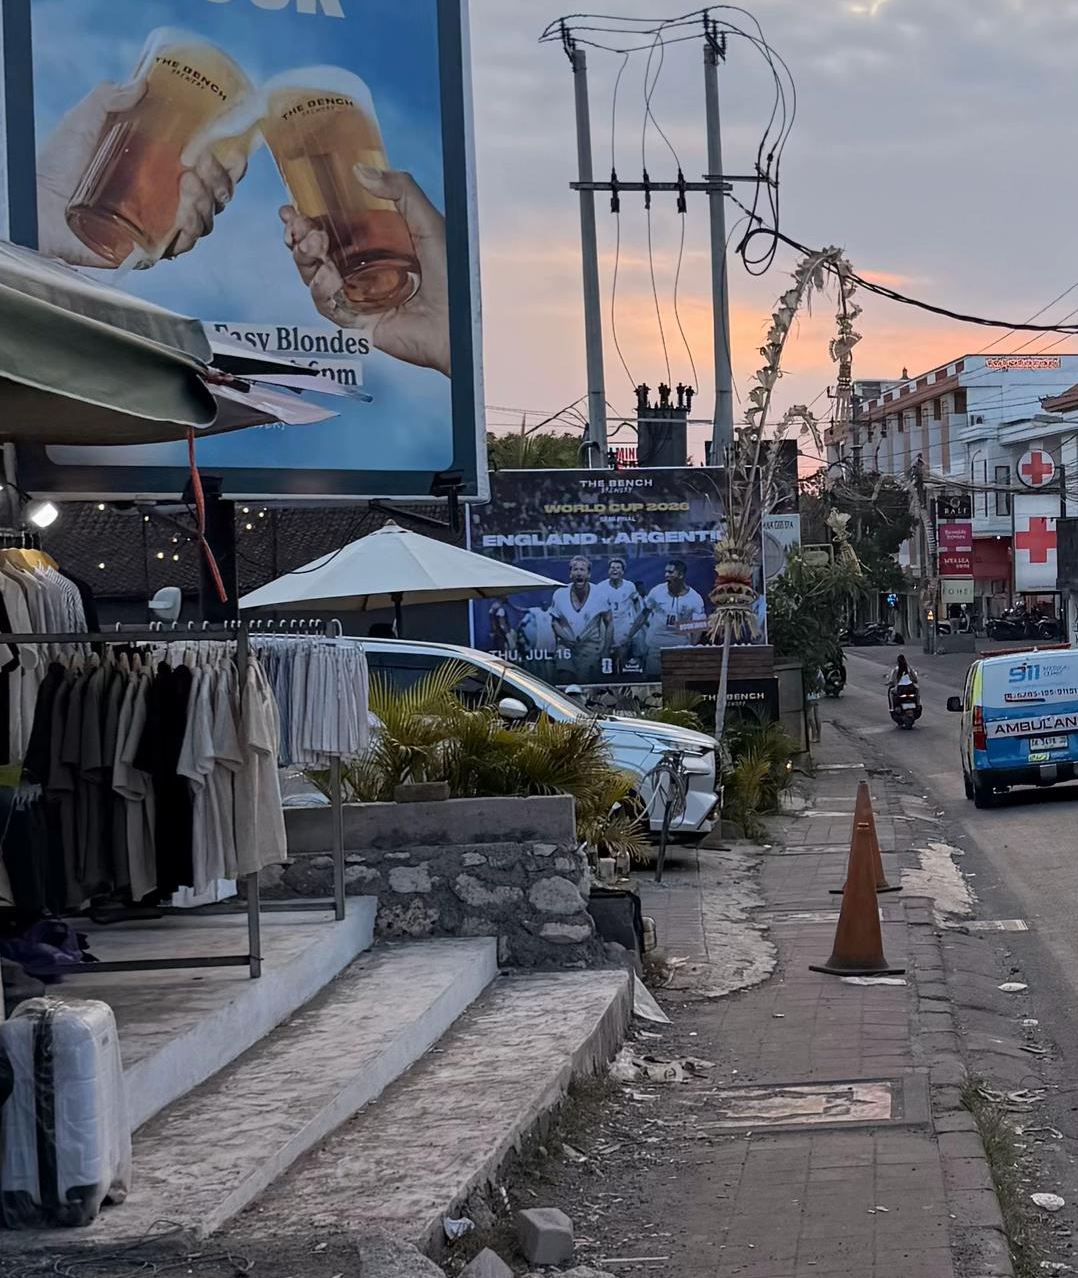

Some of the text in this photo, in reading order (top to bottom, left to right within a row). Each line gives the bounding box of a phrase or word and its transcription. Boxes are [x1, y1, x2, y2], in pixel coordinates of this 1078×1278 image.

[156, 57, 227, 101] THE BENCH
[281, 97, 354, 121] THE BENCH
[276, 327, 370, 355] Blondes
[579, 479, 653, 488] THE BENCH
[543, 502, 690, 514] WORLD CUP 2026
[482, 533, 598, 547] ENGLAND
[526, 648, 553, 660] JUL
[557, 648, 572, 659] 16
[727, 692, 765, 700] BENCH
